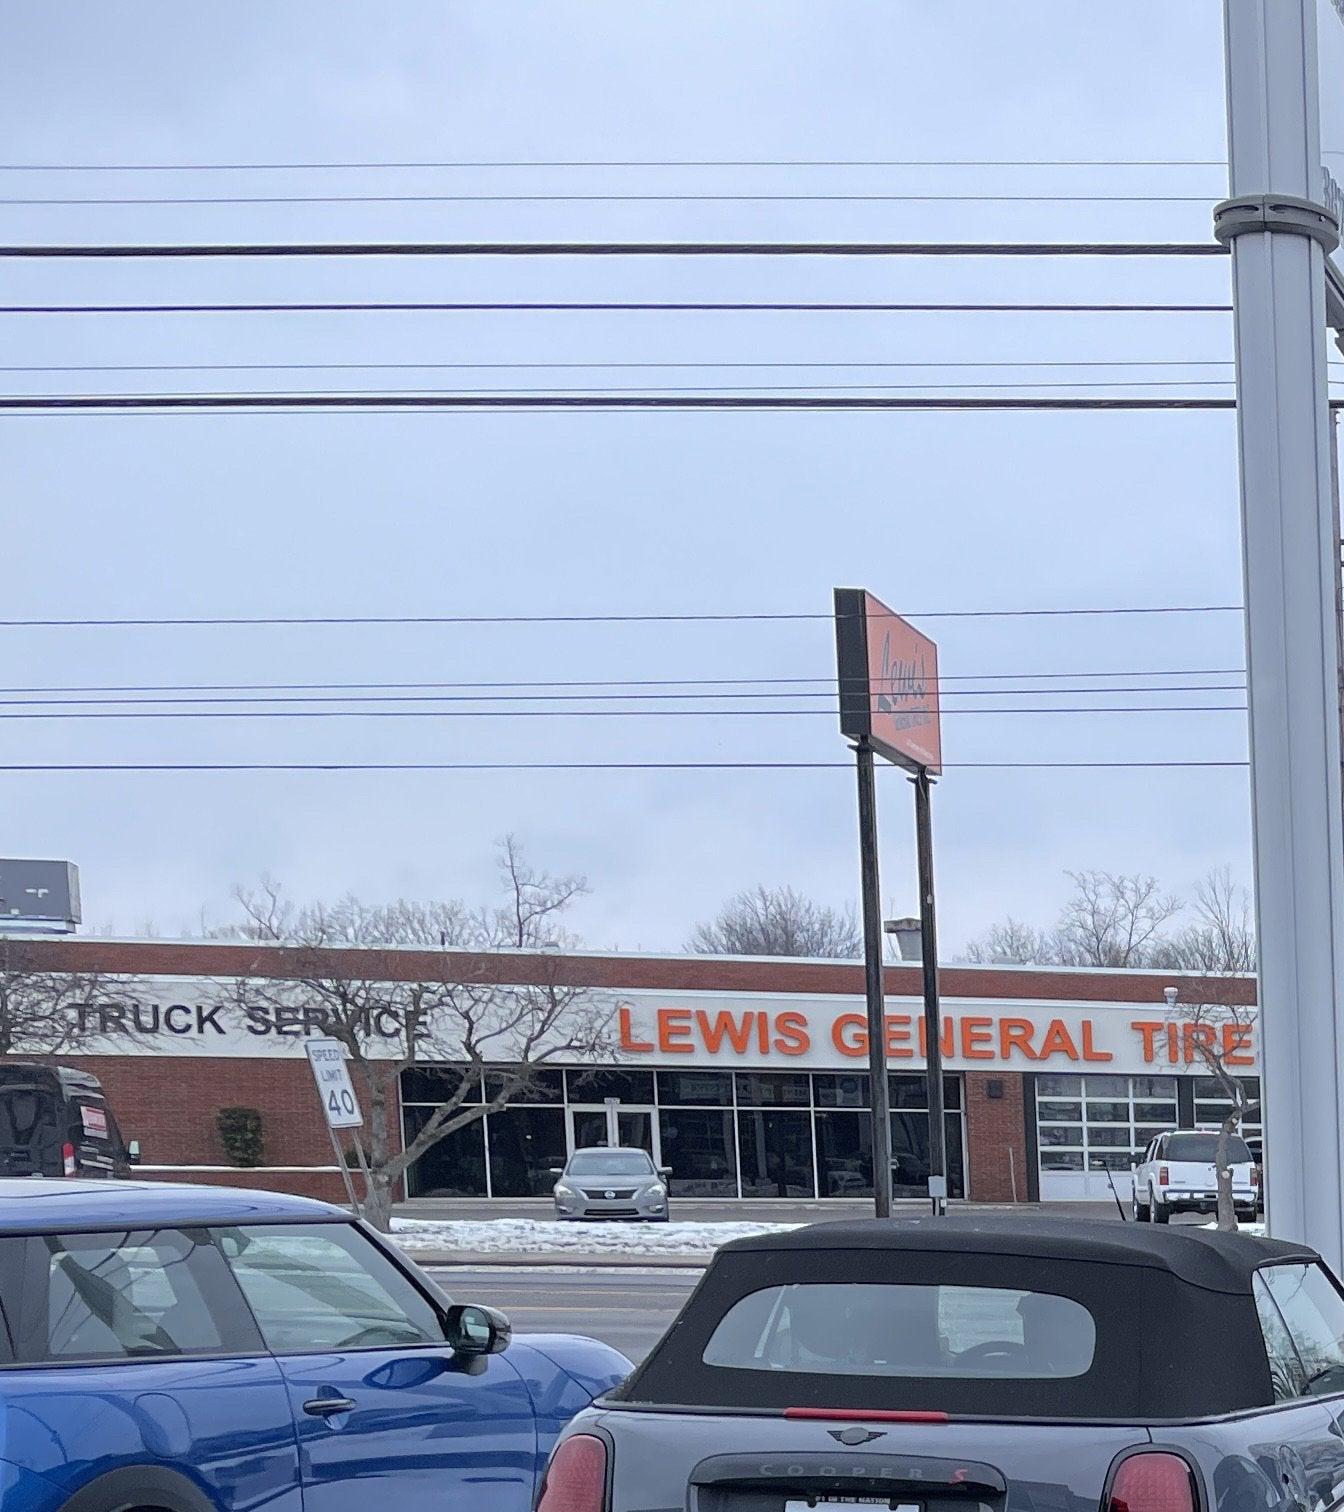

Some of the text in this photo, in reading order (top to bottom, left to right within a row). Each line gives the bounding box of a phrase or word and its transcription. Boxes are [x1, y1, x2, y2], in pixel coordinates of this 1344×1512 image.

[67, 1002, 226, 1035] TRUCK
[619, 1007, 1260, 1066] LEWIS GENERAL TIRE
[311, 1048, 340, 1062] SPEED
[320, 1068, 343, 1082] LIMIT
[328, 1088, 355, 1116] 40
[759, 1463, 969, 1485] COOPER S
[858, 1497, 891, 1505] NATION
